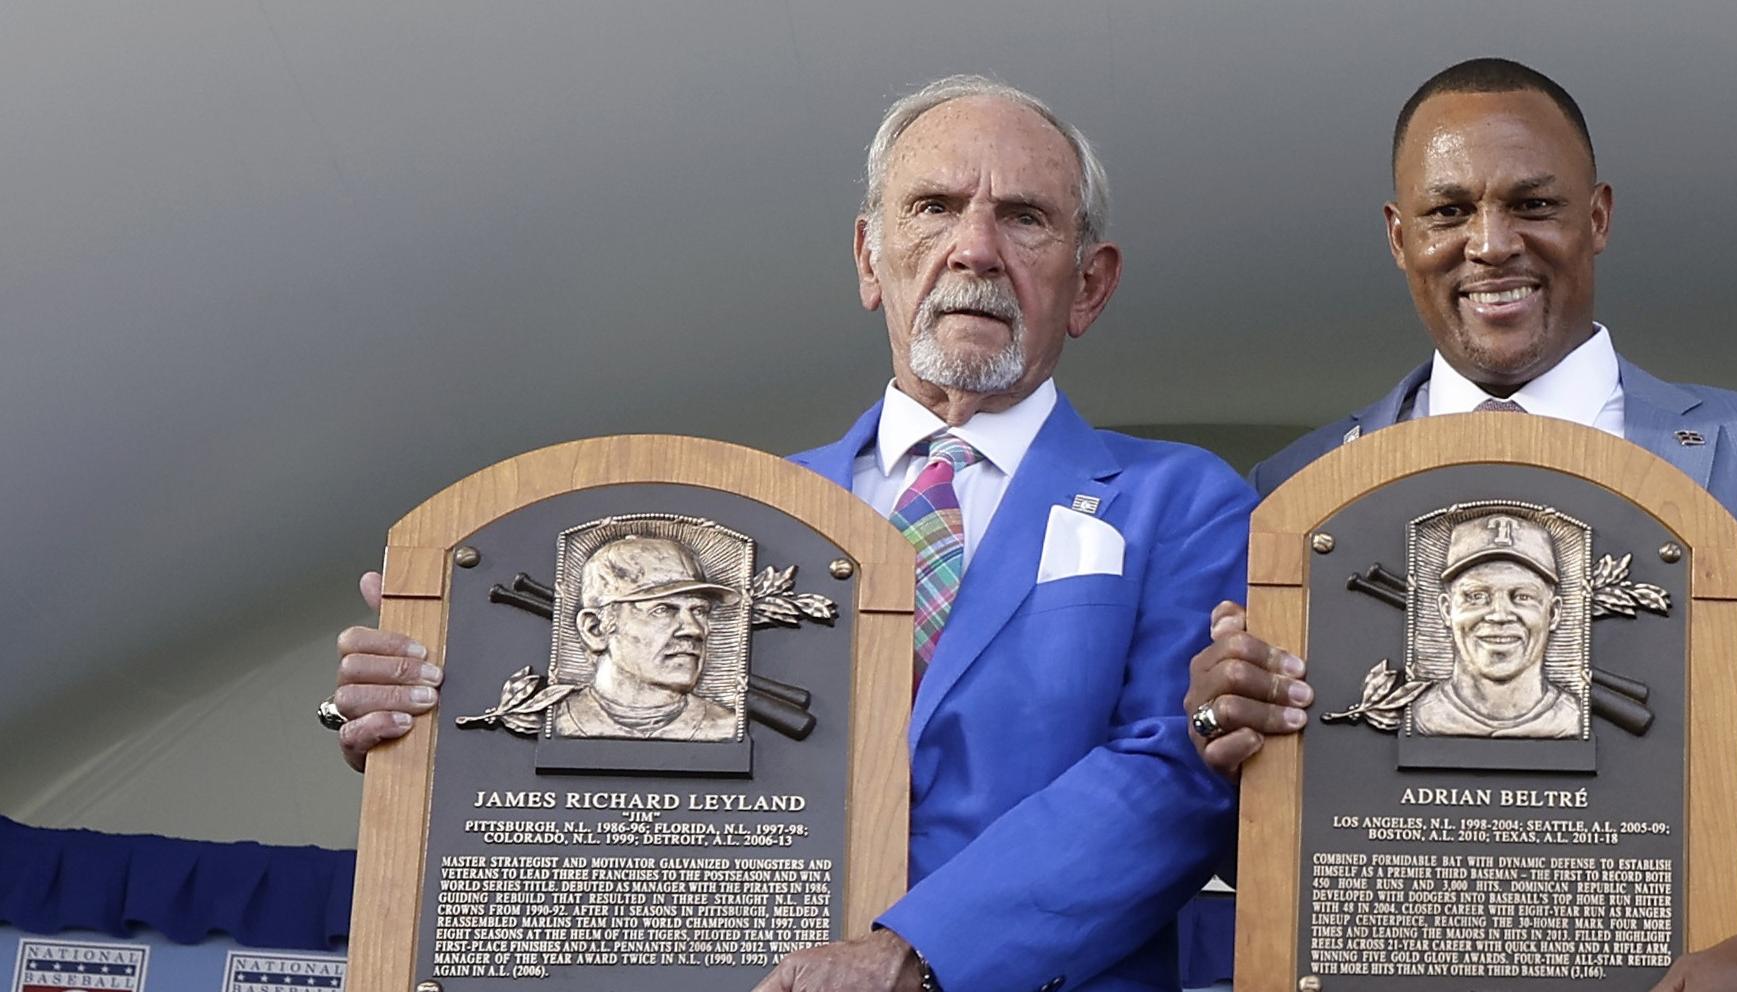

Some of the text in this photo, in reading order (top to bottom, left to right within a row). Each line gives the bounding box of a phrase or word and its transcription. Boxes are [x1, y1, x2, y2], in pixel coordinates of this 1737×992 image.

[474, 791, 804, 810] JAMES RICHARD LEYLAND
[1401, 788, 1587, 806] ADRIAN BELTRÉ
[622, 811, 660, 821] "JIM"
[465, 820, 807, 834] PITTSBURGH, N.L. 1986-96; FLORIDA, N.L. 1997-98;
[1333, 816, 1669, 833] LOS ANGELES, N.L. 1998-2004; SEATTLE, A.L. 2005-09;
[483, 832, 792, 845] COLORADO, N.L. 1999; DETROIT, A.L. 2006-13
[1368, 828, 1617, 843] BOSTON, A.L. 2010; TEXAS, A.L. 2011-18
[441, 856, 831, 869] MASTER STRATEGIST AND MOTIVATOR GALVANIZED YOUNGSTERS AND
[1313, 853, 1671, 870] COMBINED FORMIDABLE BAT WITH DYNAMIC DEFENSE TO ESTABLISH
[25, 946, 139, 962] NATIONAL
[236, 959, 342, 974] NATIONAL
[433, 965, 548, 976] AGAIN IN A.L. (2006).
[1310, 962, 1605, 978] WITH MORE HITS THAN ANY OTHER THIRD BASEMAN (3,166).
[24, 972, 133, 988] BASEBALL
